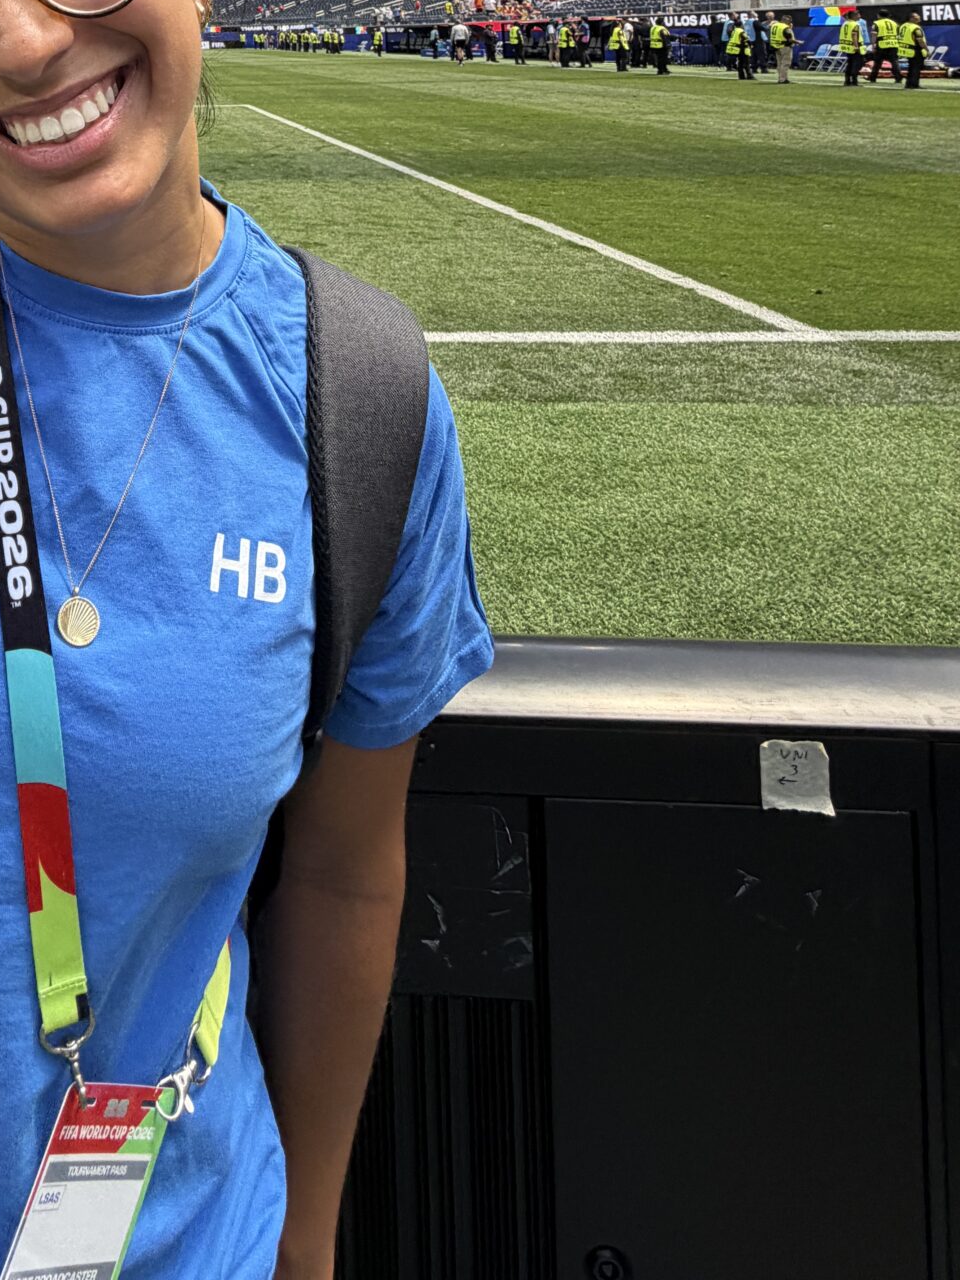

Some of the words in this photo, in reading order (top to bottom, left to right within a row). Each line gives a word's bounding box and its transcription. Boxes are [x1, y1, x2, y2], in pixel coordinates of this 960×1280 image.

[922, 4, 955, 22] FIFA
[650, 16, 672, 28] YU
[674, 14, 698, 27] LOS
[211, 41, 226, 49] FIFA
[210, 532, 288, 604] HB
[791, 764, 799, 776] 3
[59, 1124, 79, 1141] FIFA
[79, 1124, 110, 1141] WORLD
[109, 1124, 128, 1140] CUP
[126, 1125, 155, 1141] 2026
[67, 1164, 110, 1177] TOURNAMENT
[109, 1164, 128, 1176] PASS
